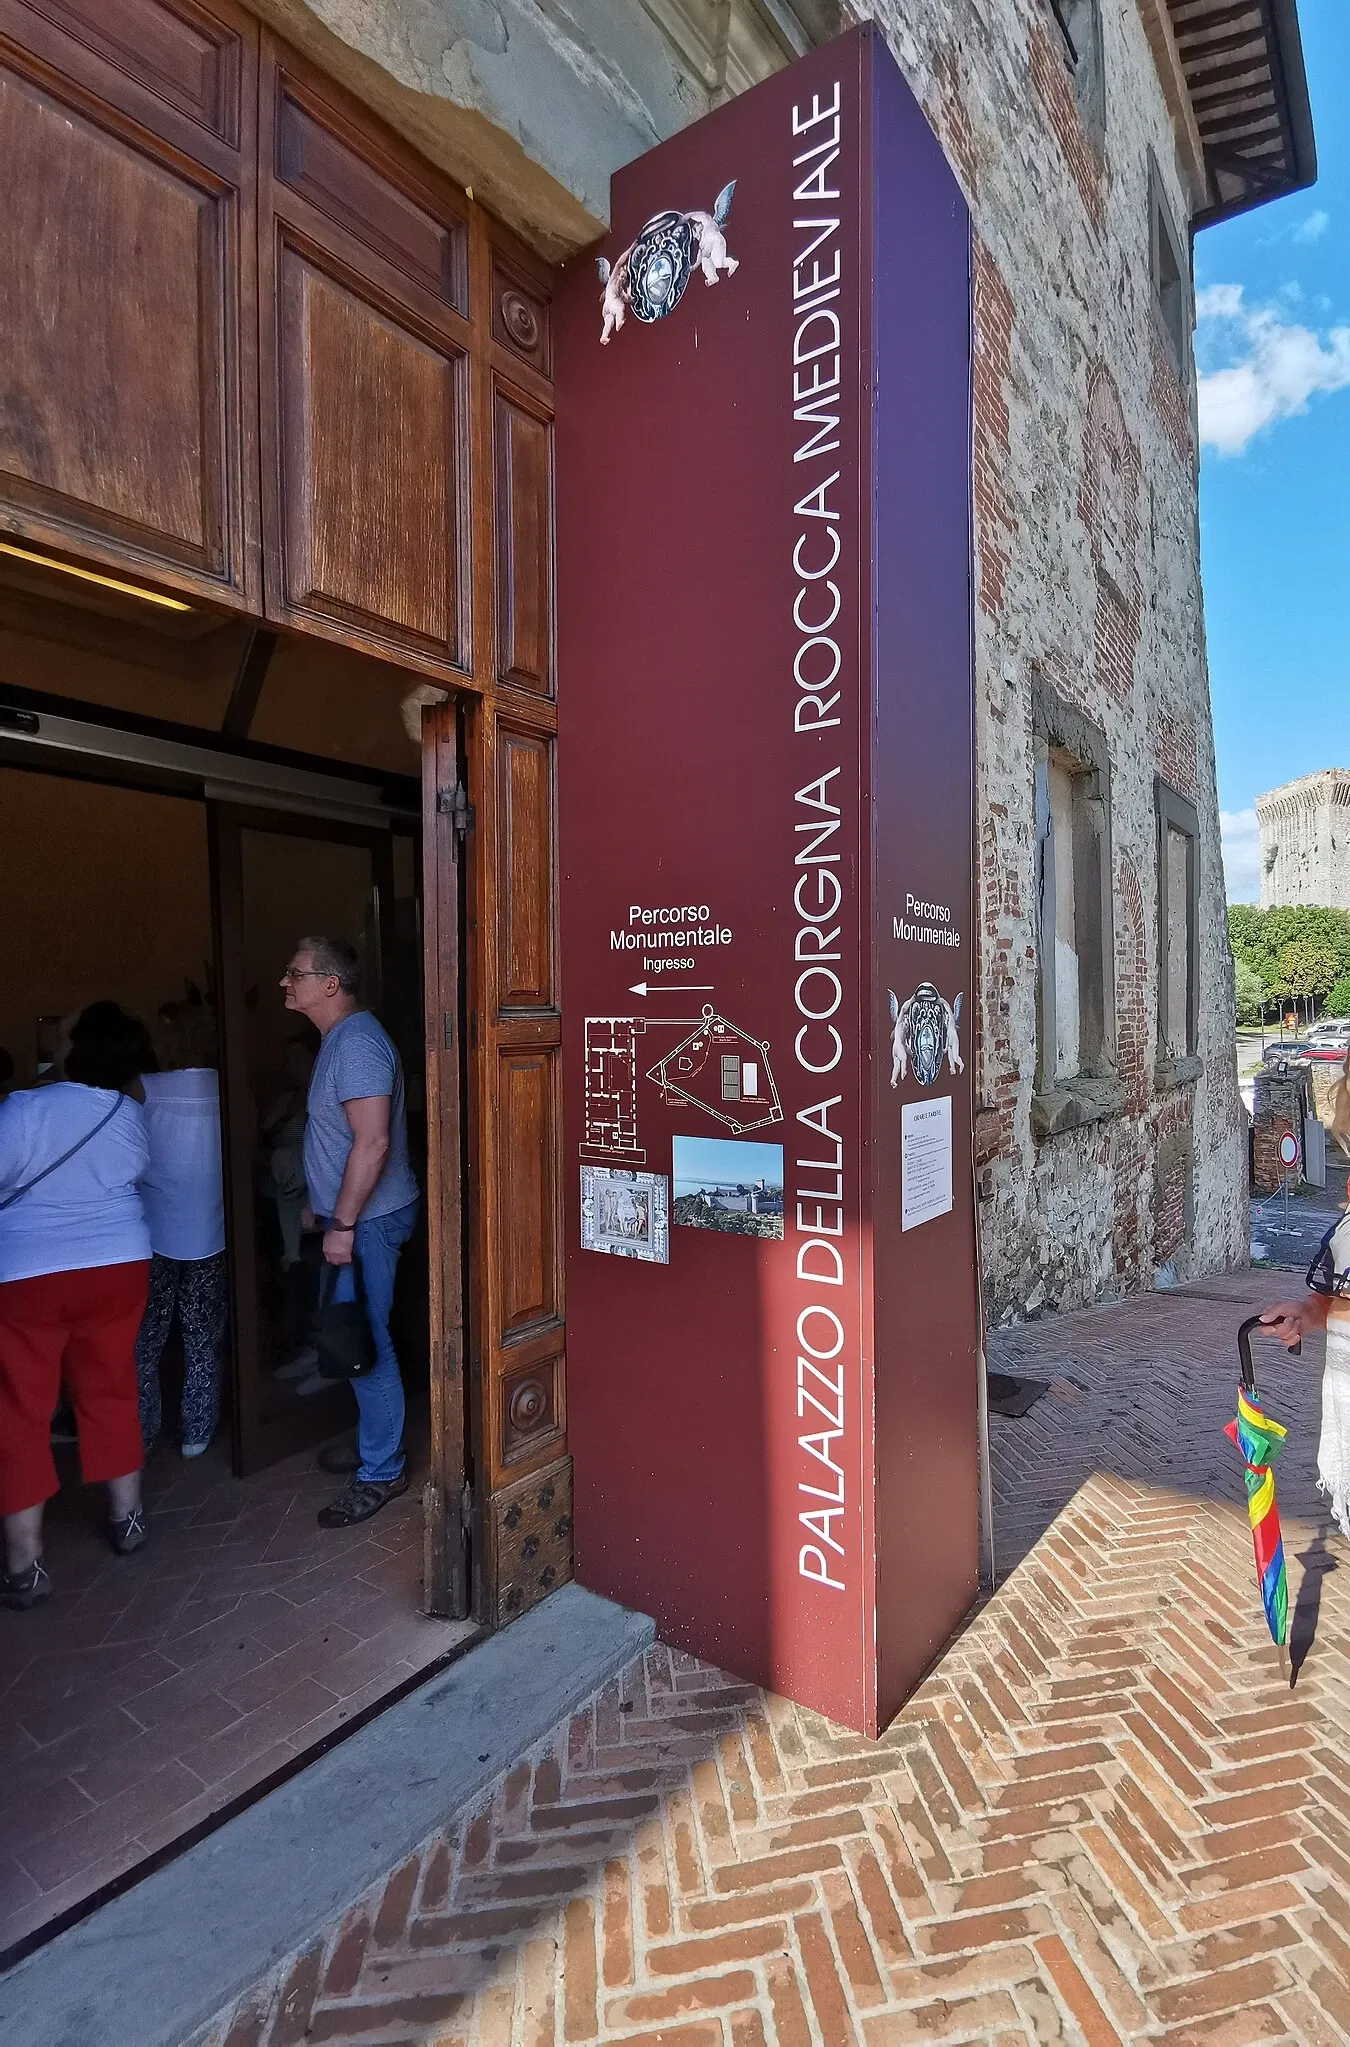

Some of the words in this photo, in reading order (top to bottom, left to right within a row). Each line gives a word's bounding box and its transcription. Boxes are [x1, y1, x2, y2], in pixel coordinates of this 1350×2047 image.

[792, 81, 842, 464] MEDIEVALE
[793, 470, 842, 733] ROCCA
[610, 923, 733, 951] Monumentale
[629, 904, 710, 926] Percorso
[794, 765, 843, 1073] CORGNA
[893, 916, 961, 948] Monumentale
[906, 892, 951, 924] Percorso
[643, 956, 695, 974] Ingresso
[795, 1094, 845, 1286] DELLA
[796, 1305, 846, 1592] PALAZZO
